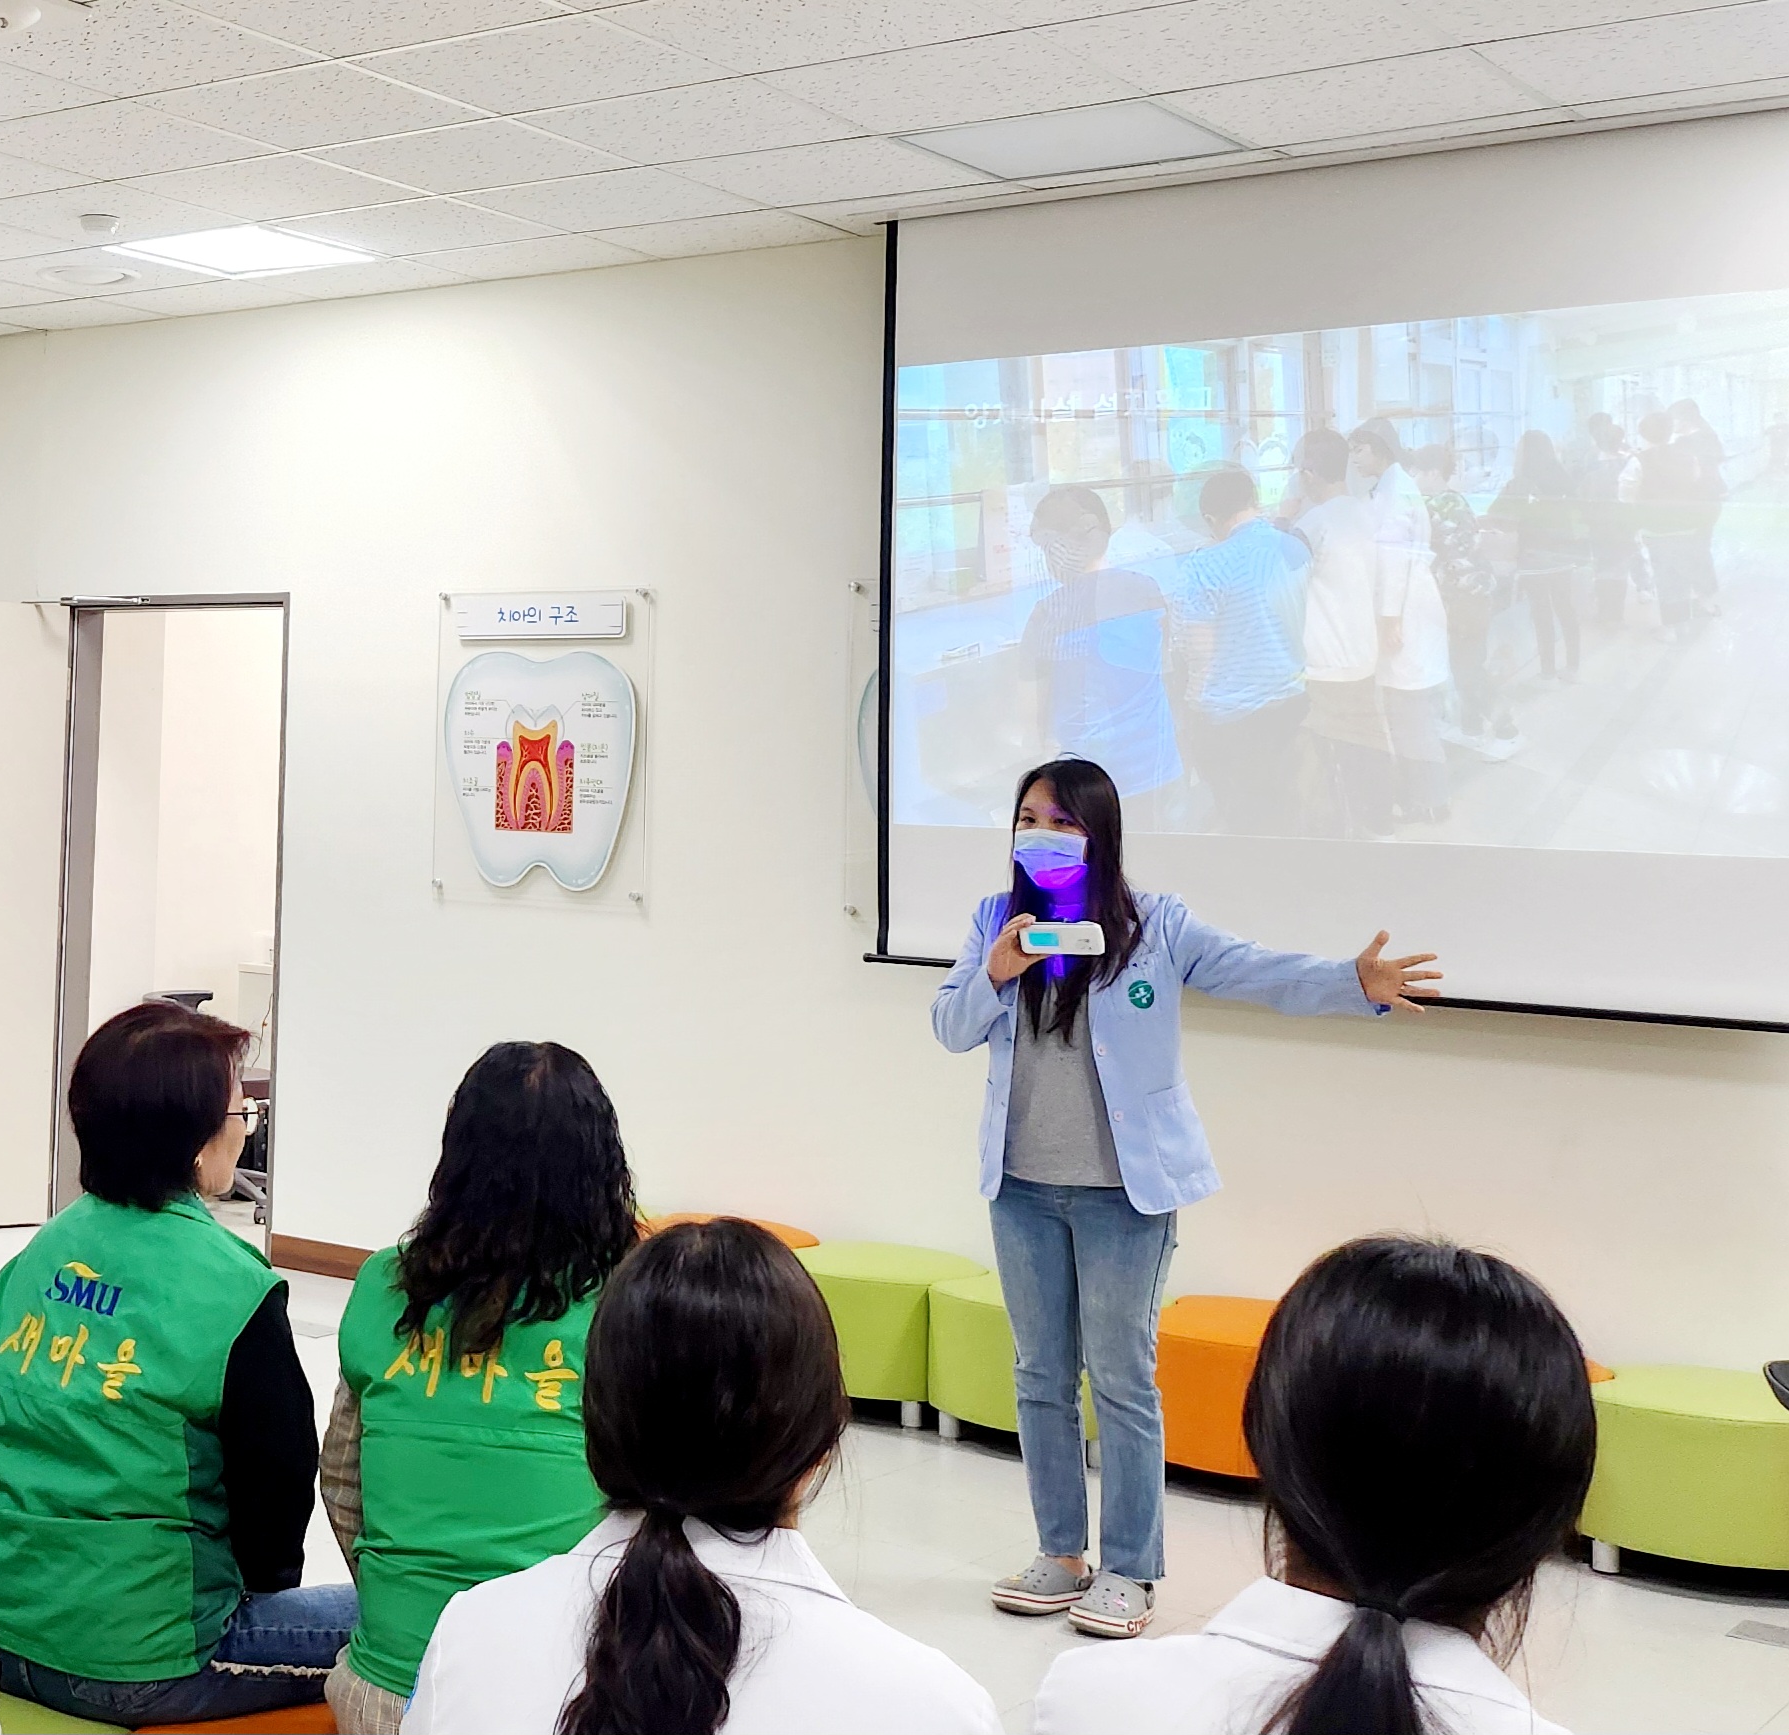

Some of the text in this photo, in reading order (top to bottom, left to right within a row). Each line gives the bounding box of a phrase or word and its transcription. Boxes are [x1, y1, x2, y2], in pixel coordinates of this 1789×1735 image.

[497, 605, 580, 626] 치아의 구조
[44, 1267, 123, 1317] SMU
[384, 1326, 580, 1411] 새마을
